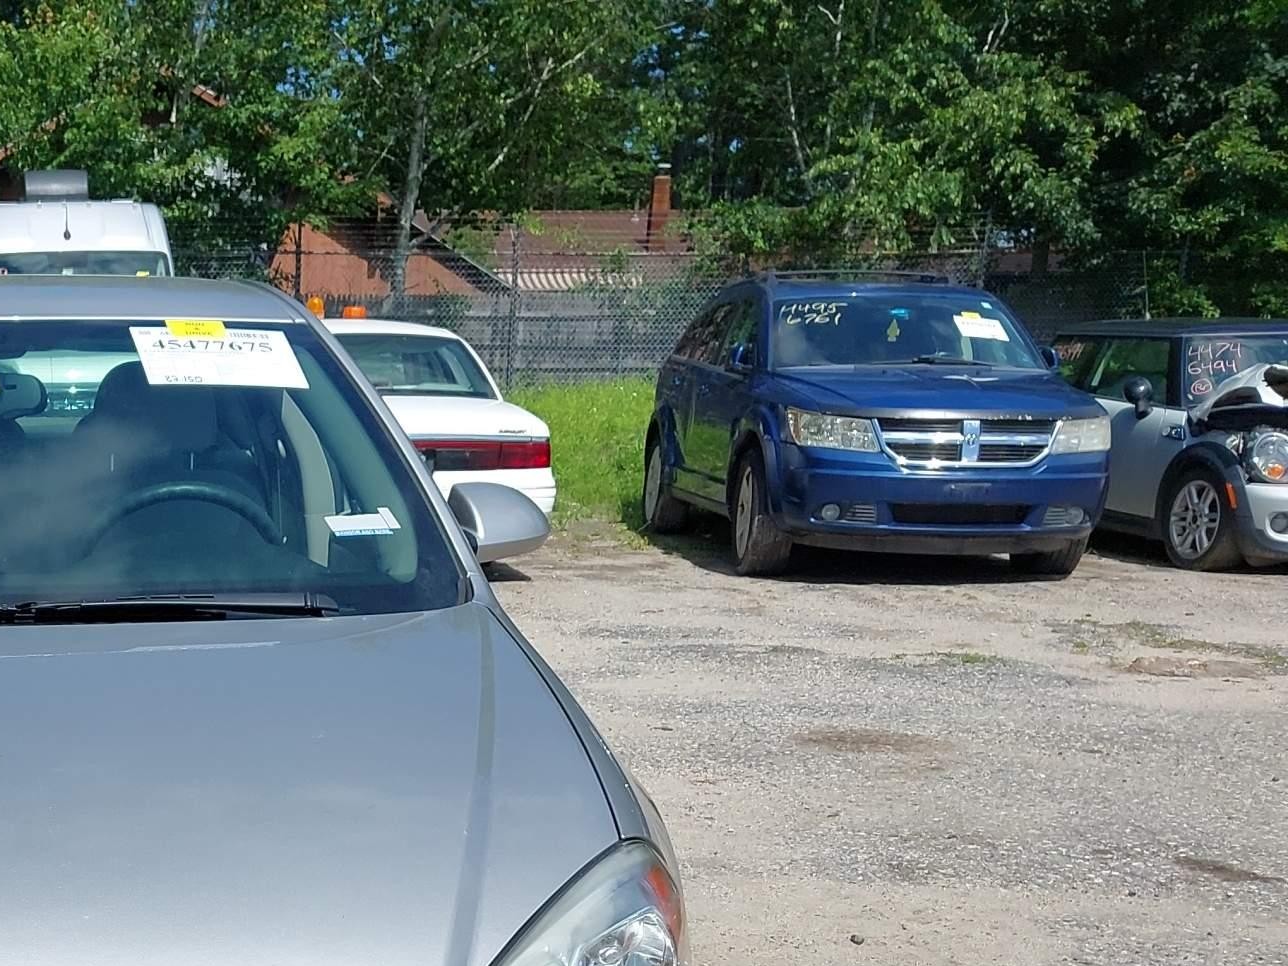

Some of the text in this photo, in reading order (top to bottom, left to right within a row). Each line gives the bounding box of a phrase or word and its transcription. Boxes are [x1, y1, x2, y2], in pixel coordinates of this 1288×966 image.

[151, 338, 273, 353] 45477675
[1187, 342, 1242, 361] 4474
[1187, 359, 1238, 375] 6494
